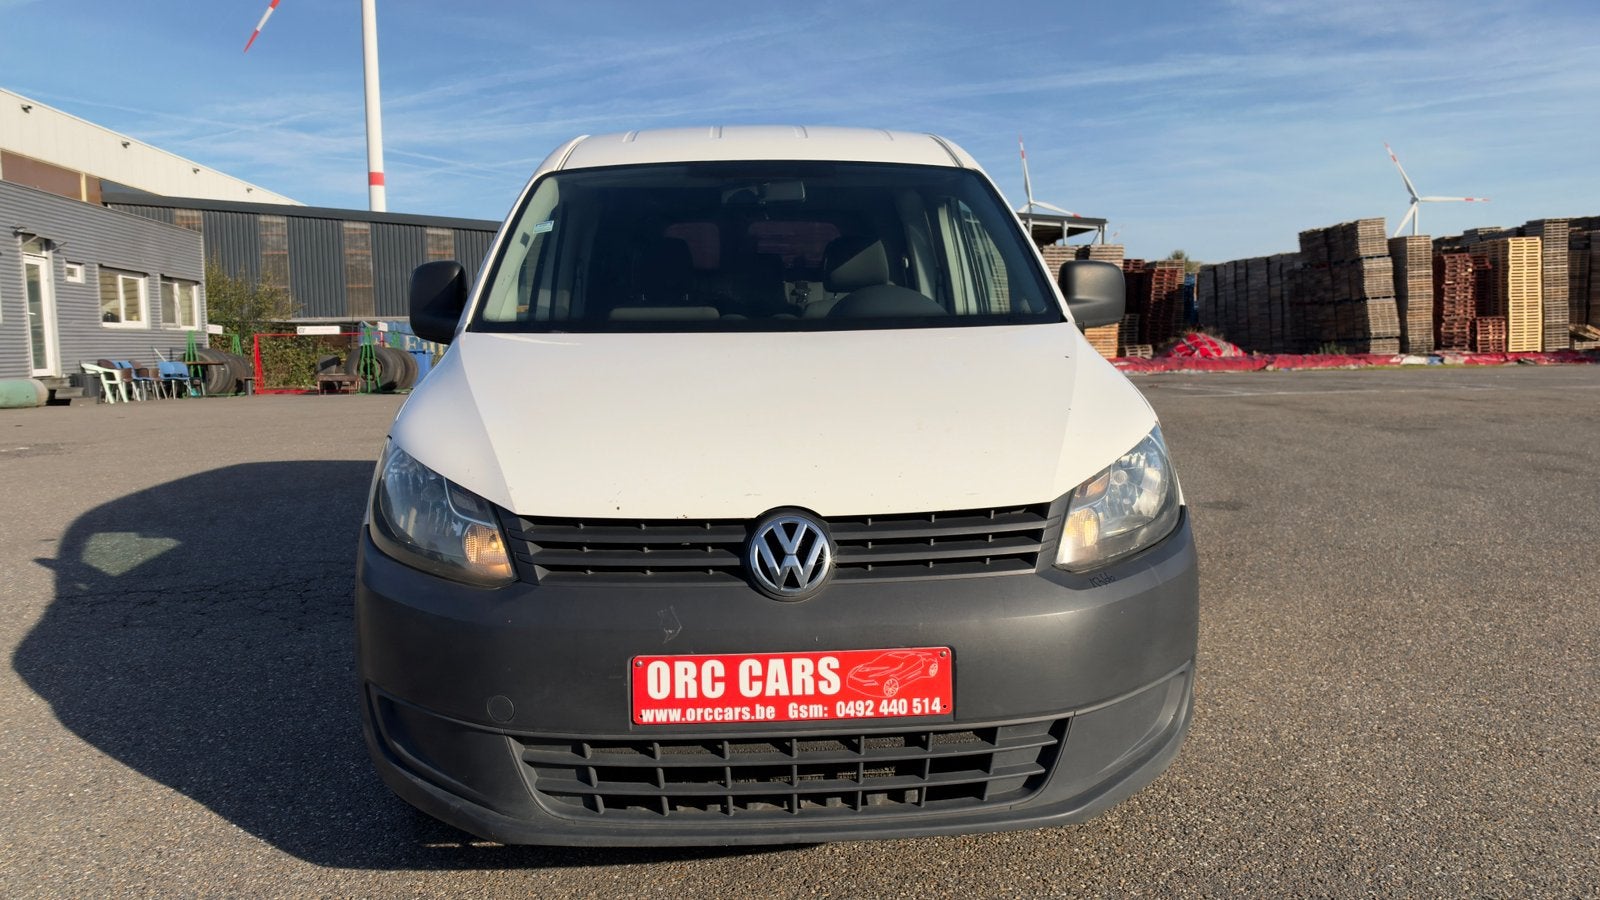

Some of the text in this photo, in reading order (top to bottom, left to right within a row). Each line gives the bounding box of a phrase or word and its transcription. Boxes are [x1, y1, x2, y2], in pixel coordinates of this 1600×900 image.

[751, 516, 831, 597] VW
[647, 656, 841, 699] ORC CARS
[641, 697, 941, 722] www.orccars.be Gsm: 0492 440 514
